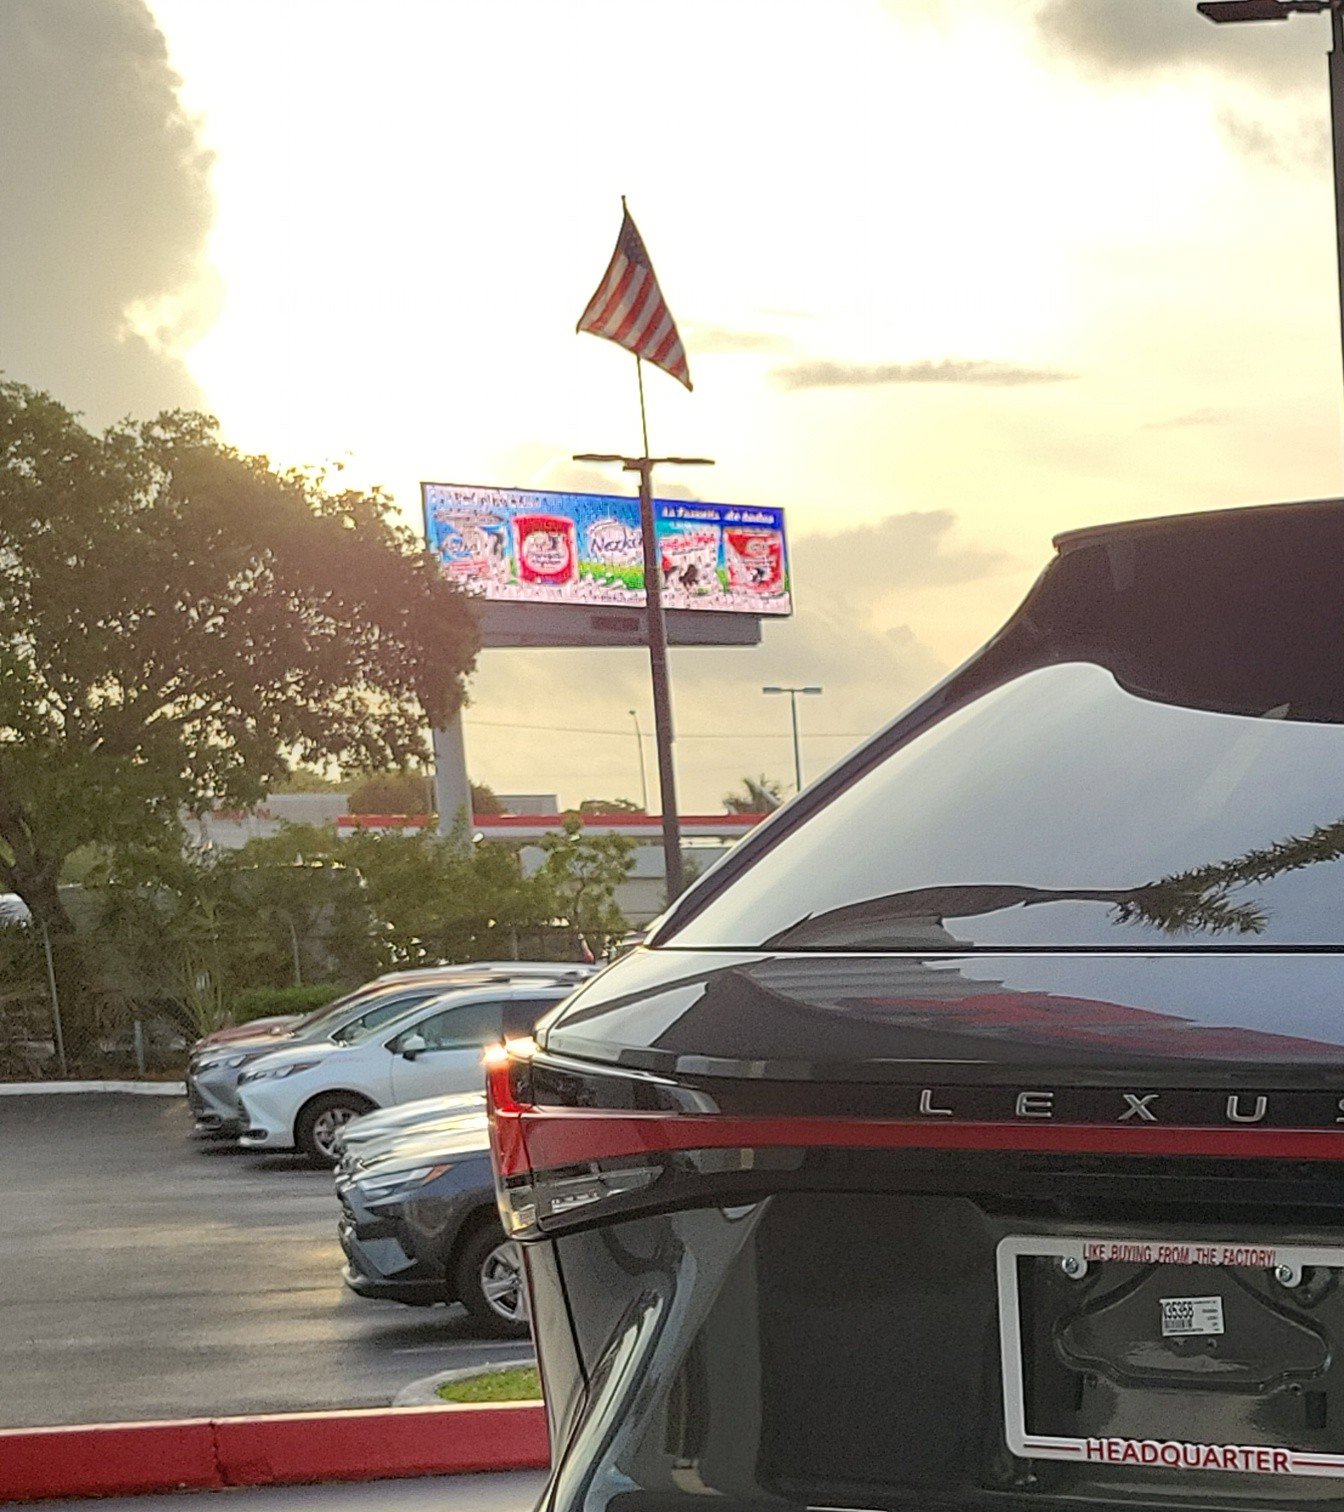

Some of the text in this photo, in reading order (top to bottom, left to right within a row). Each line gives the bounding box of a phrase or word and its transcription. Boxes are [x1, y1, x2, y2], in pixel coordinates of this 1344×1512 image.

[1083, 1243, 1277, 1267] LIKE BUYING FROM THE FACTORY!
[1085, 1440, 1291, 1472] HEADQUARTER
